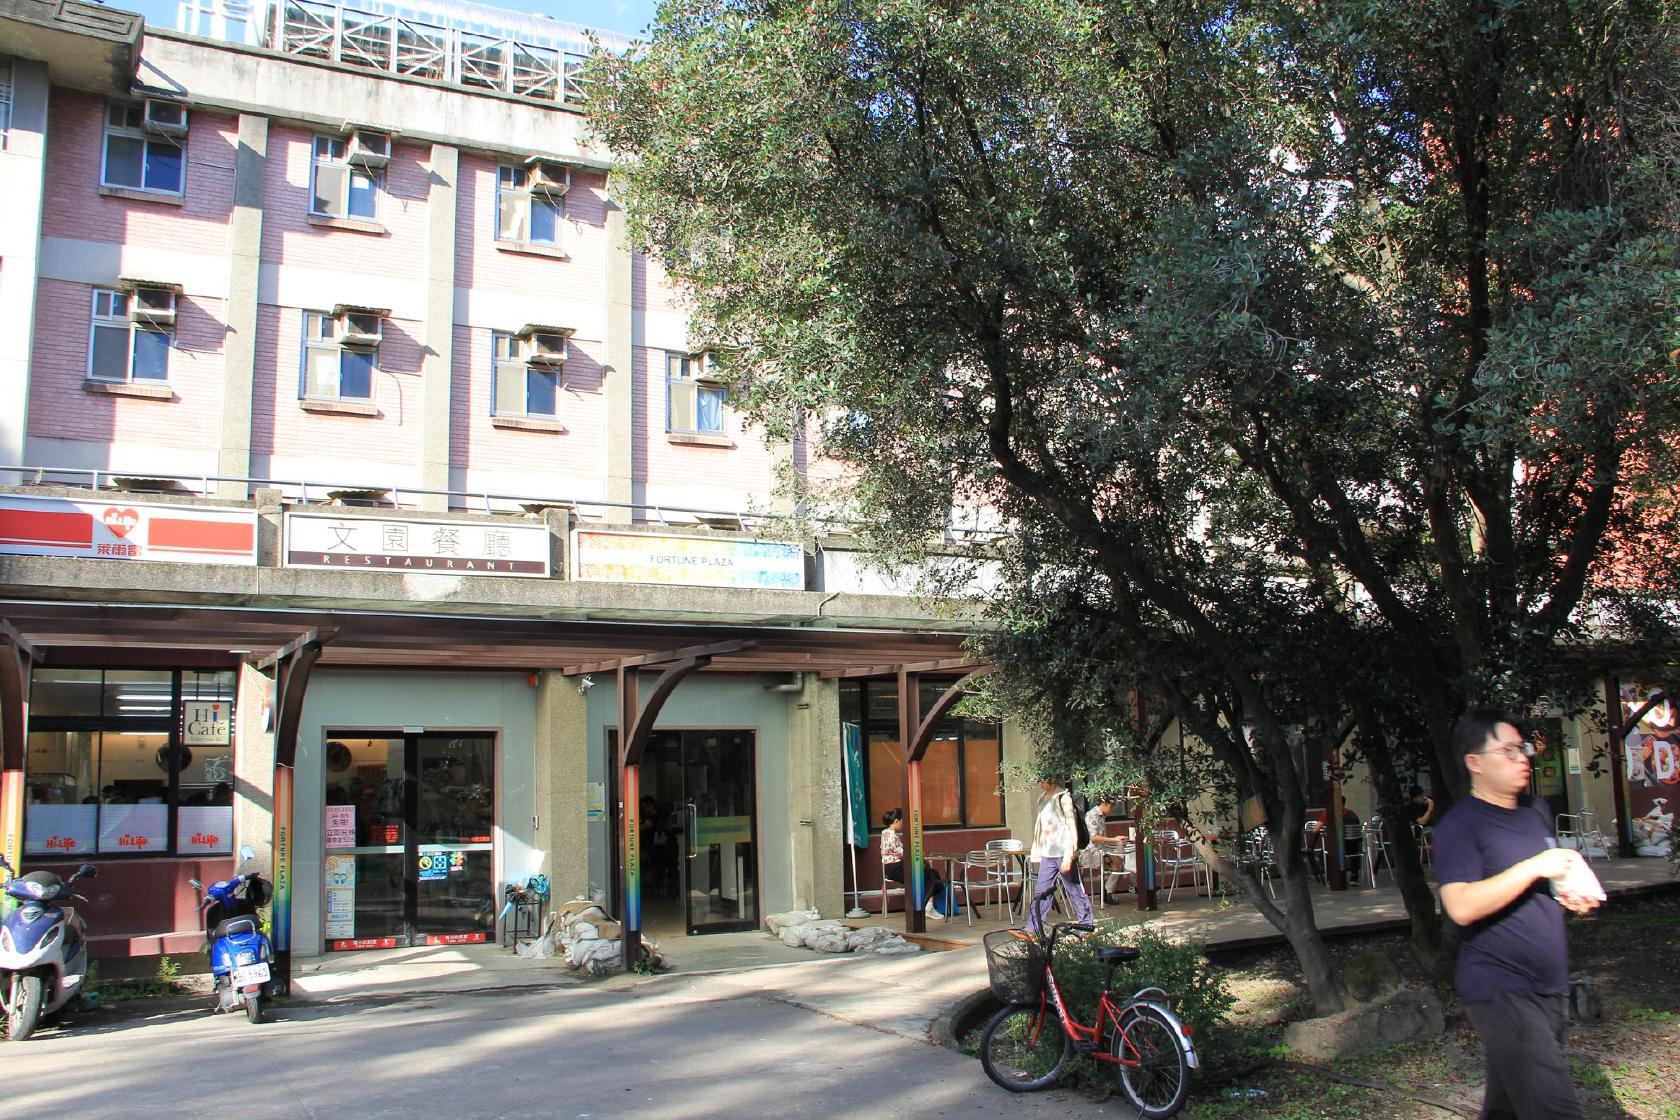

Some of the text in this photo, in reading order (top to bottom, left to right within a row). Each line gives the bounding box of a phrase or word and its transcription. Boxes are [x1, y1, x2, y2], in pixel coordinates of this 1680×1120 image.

[327, 521, 513, 557] 文園餐廳
[97, 543, 142, 556] 萊爾富
[322, 554, 515, 570] RESTAURANT
[650, 554, 734, 566] FORTUNE PLAZA
